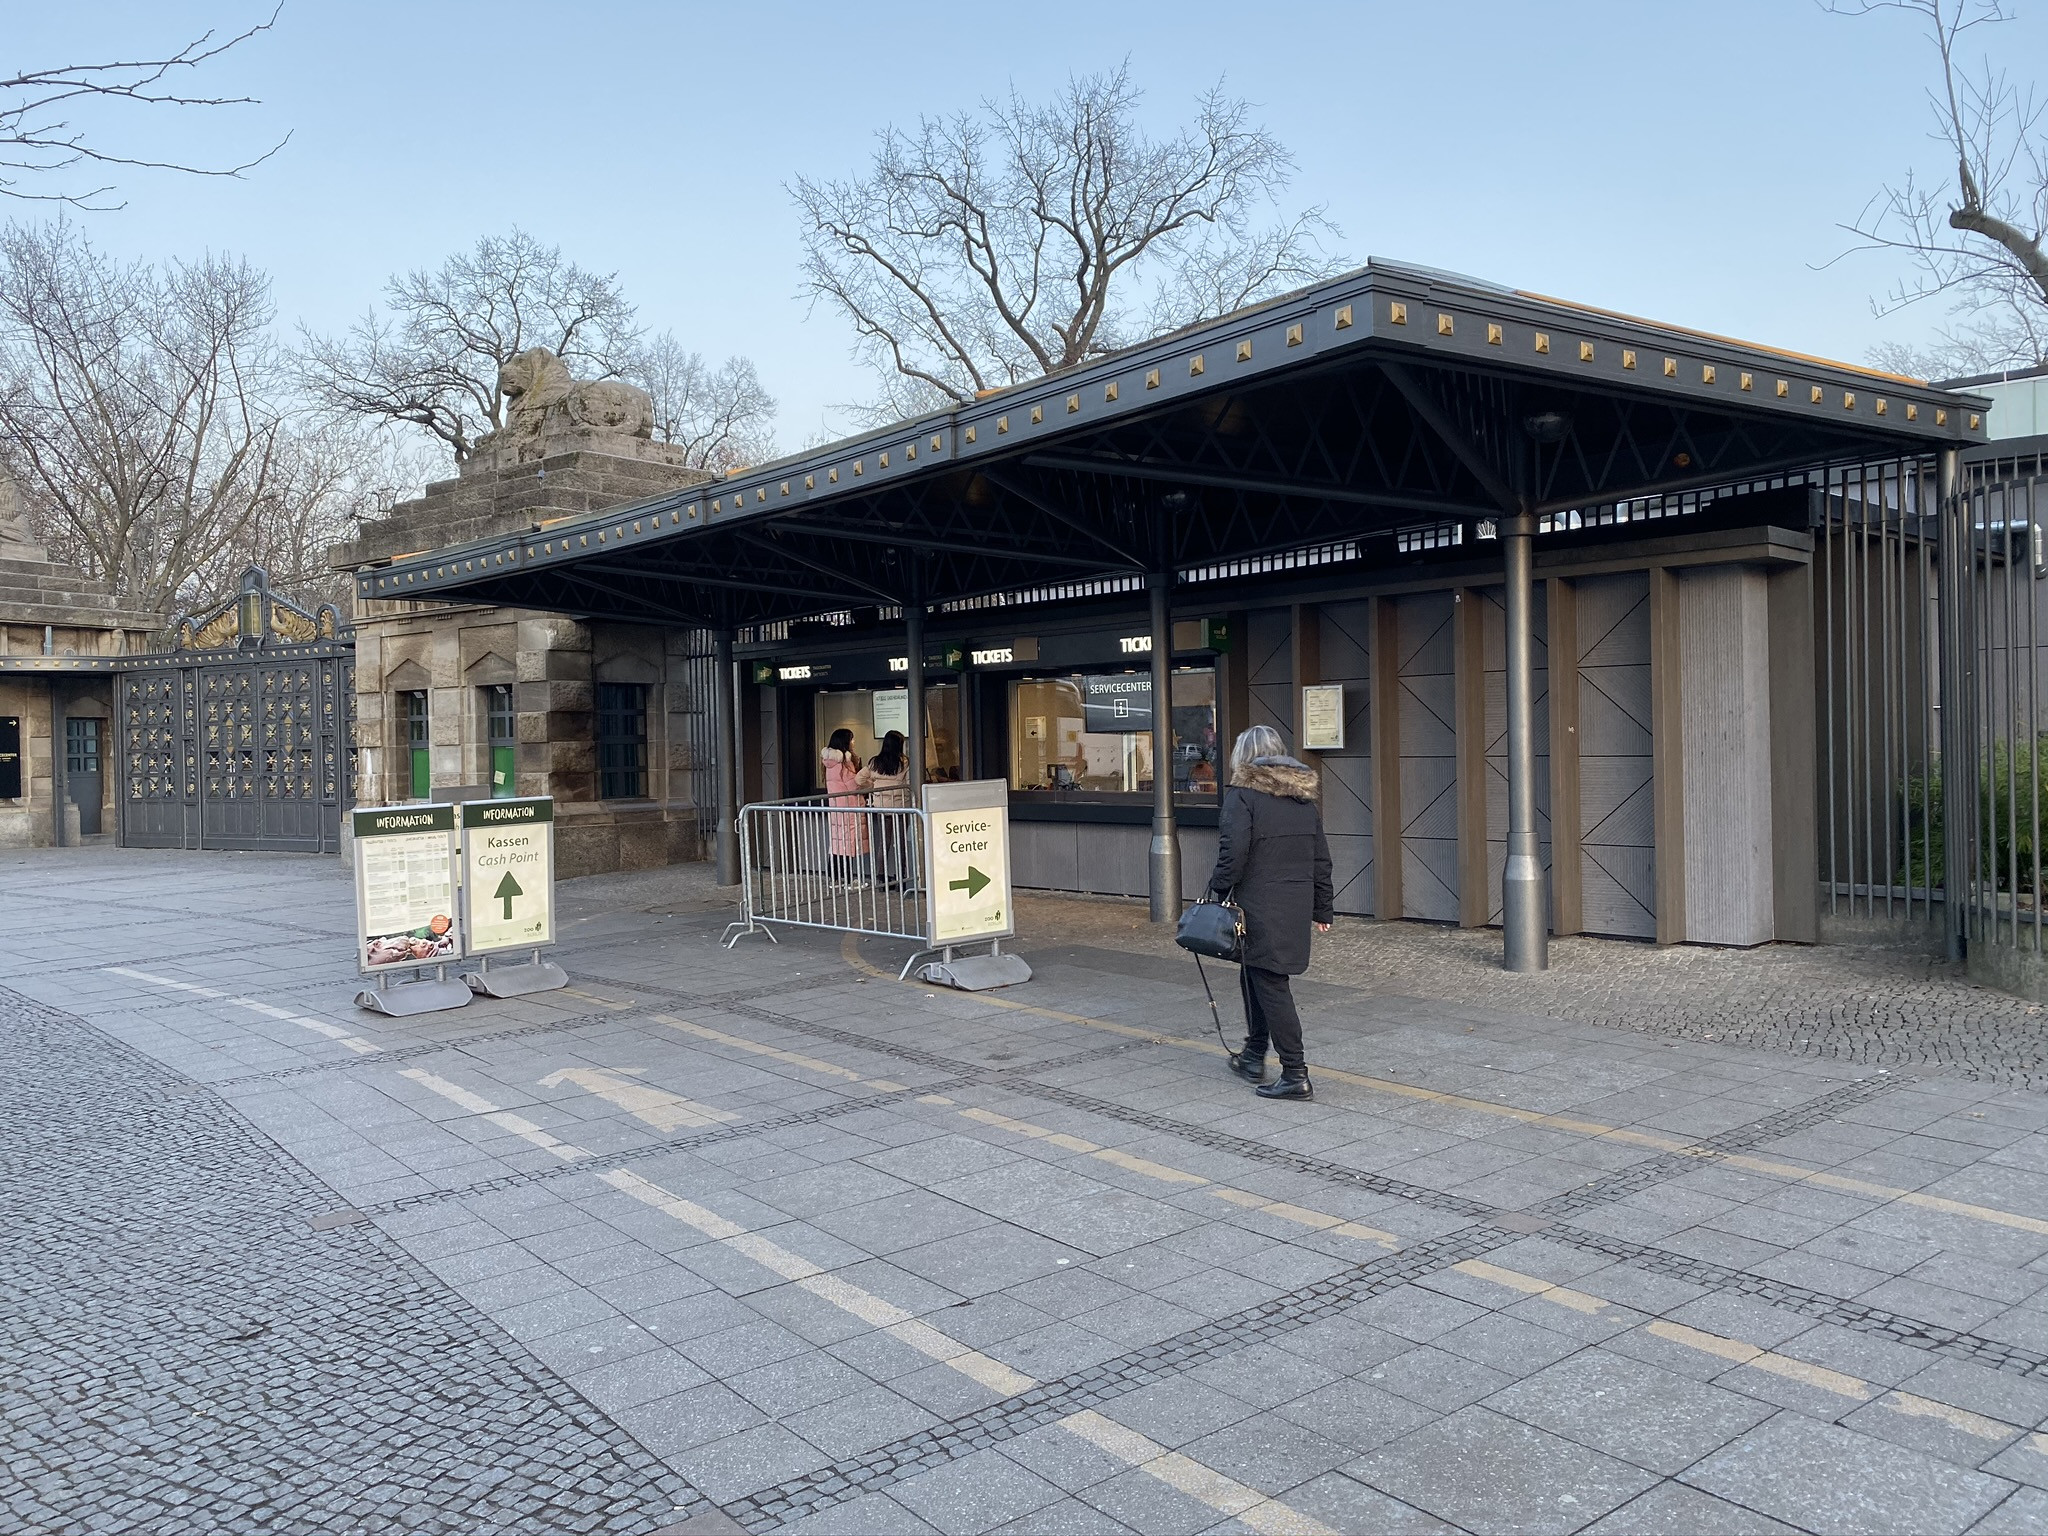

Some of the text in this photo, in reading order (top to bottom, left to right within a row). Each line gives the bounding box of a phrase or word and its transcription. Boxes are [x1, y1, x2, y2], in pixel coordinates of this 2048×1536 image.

[1119, 636, 1152, 653] TICK
[971, 648, 1013, 665] TICKETS
[778, 665, 811, 680] TICKETS
[1090, 681, 1152, 694] SERVICECENTER
[945, 820, 991, 835] Service-
[488, 837, 529, 848] Kassen
[950, 841, 988, 853] Center
[478, 851, 539, 866] Cash Point
